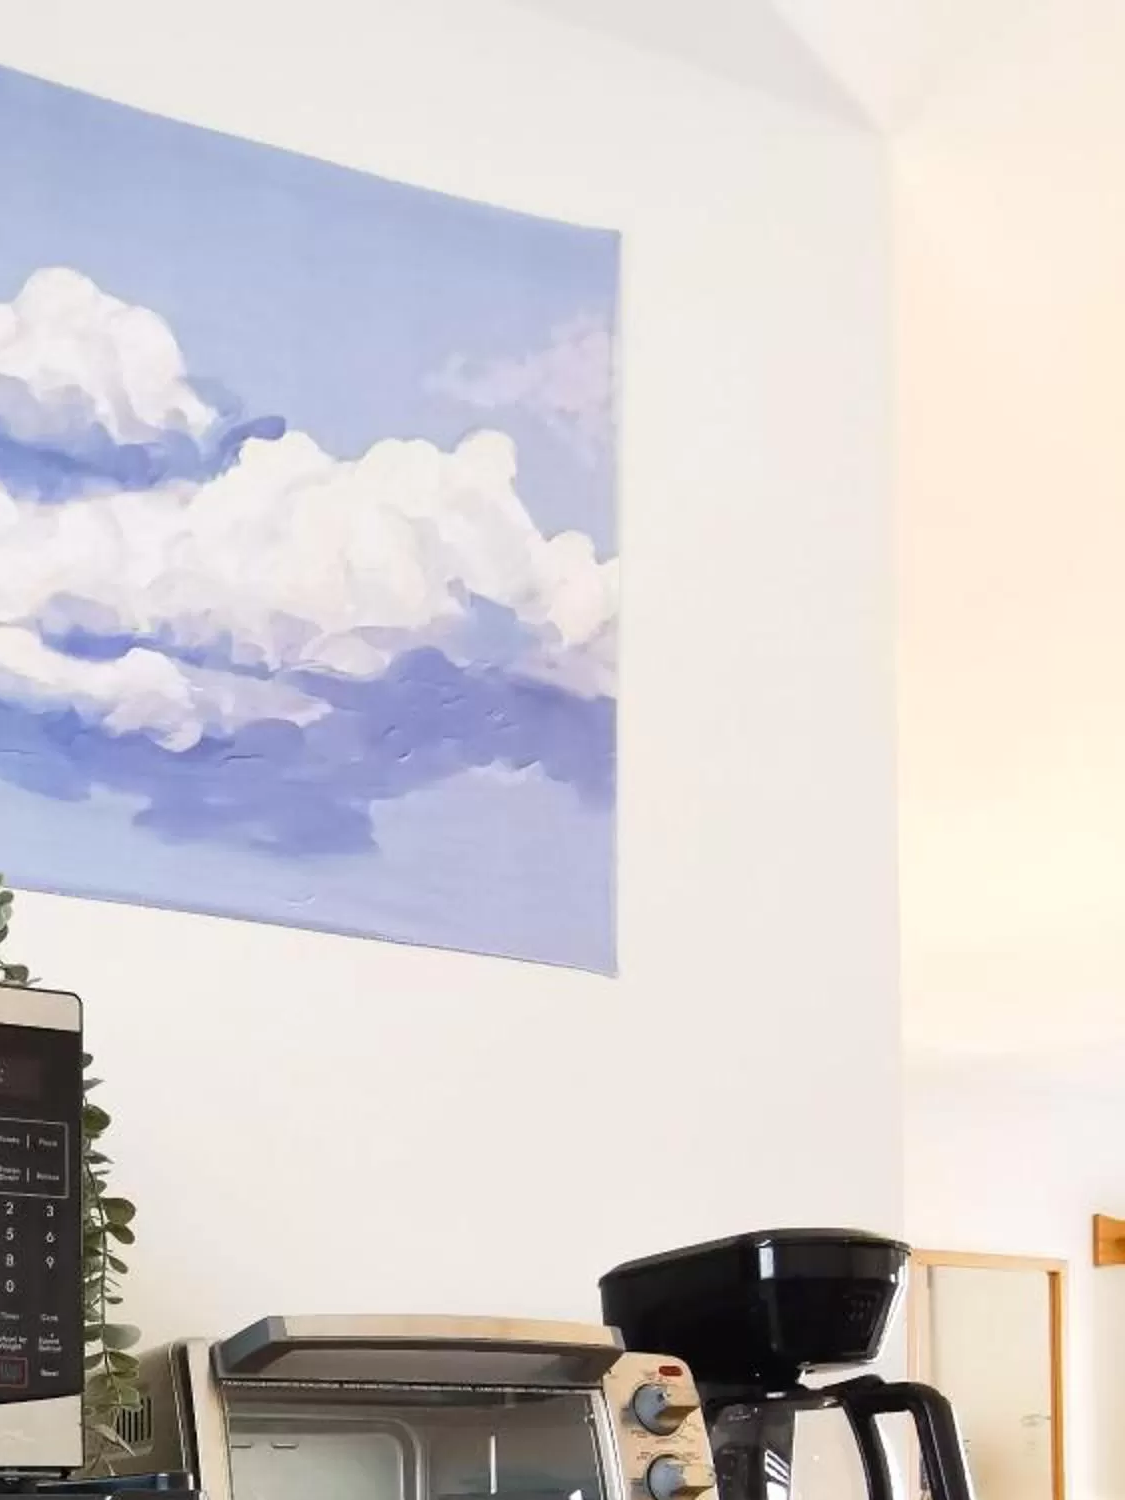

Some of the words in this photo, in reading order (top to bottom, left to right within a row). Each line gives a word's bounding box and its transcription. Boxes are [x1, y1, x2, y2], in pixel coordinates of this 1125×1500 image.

[5, 1201, 15, 1215] 2
[46, 1204, 55, 1217] 3
[5, 1227, 15, 1241] 5
[45, 1231, 55, 1243] 6
[5, 1253, 15, 1268] 8
[45, 1256, 55, 1269] 9
[5, 1279, 15, 1293] 0
